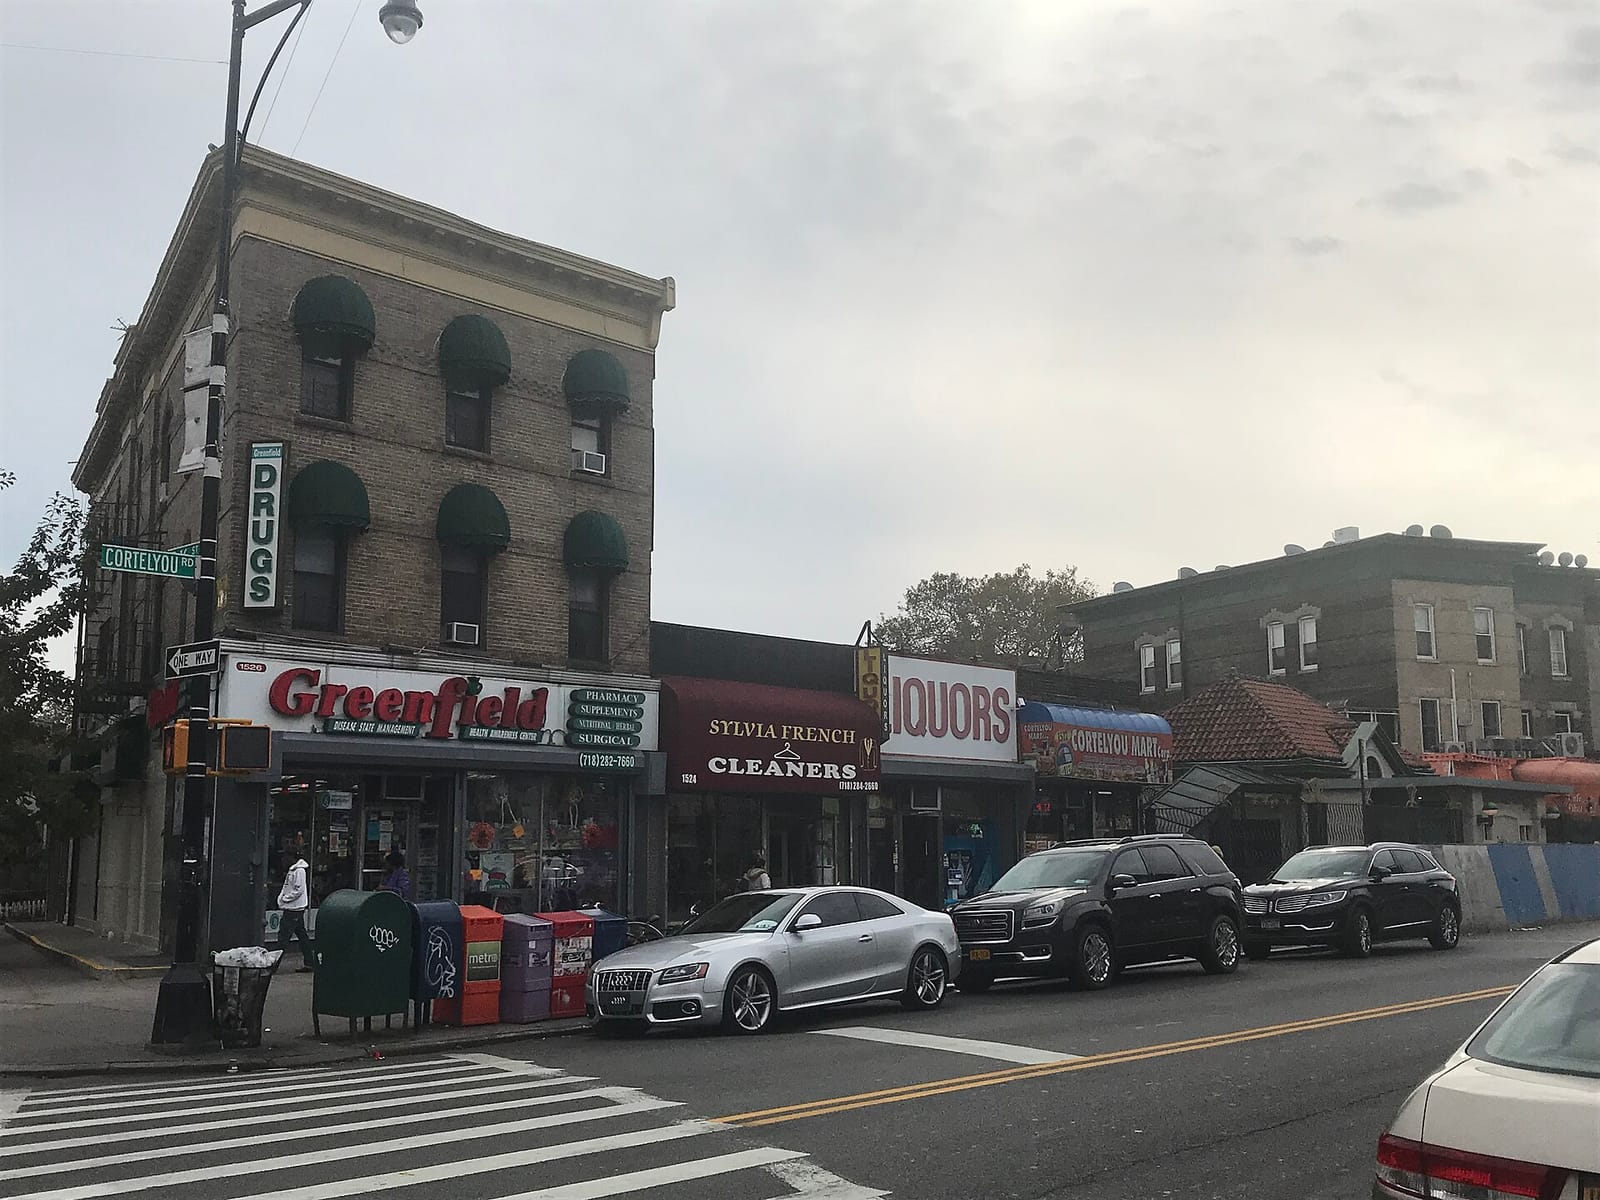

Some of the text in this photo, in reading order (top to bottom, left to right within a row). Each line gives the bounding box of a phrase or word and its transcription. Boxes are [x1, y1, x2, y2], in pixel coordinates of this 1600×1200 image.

[249, 463, 278, 602] DRUGS
[105, 547, 194, 574] CORTELYOU RD
[173, 651, 213, 669] ONE WAY
[239, 663, 264, 671] 1526
[269, 667, 549, 738] Greenfield
[586, 690, 639, 704] PHARMACY
[580, 704, 638, 718] SUPPLEMENTS
[892, 676, 1010, 743] IQUORS
[333, 721, 416, 734] DISEASE STATE MANAGEMENT
[708, 719, 856, 744] SYLVIA FRENCH
[578, 733, 634, 746] SURGICAL
[1071, 728, 1129, 756] CORTELYOU
[1131, 735, 1158, 758] MART
[579, 752, 635, 768] (718)282-7660
[707, 757, 857, 780] CLEANERS
[681, 774, 697, 785] 1524
[469, 953, 497, 964] metro
